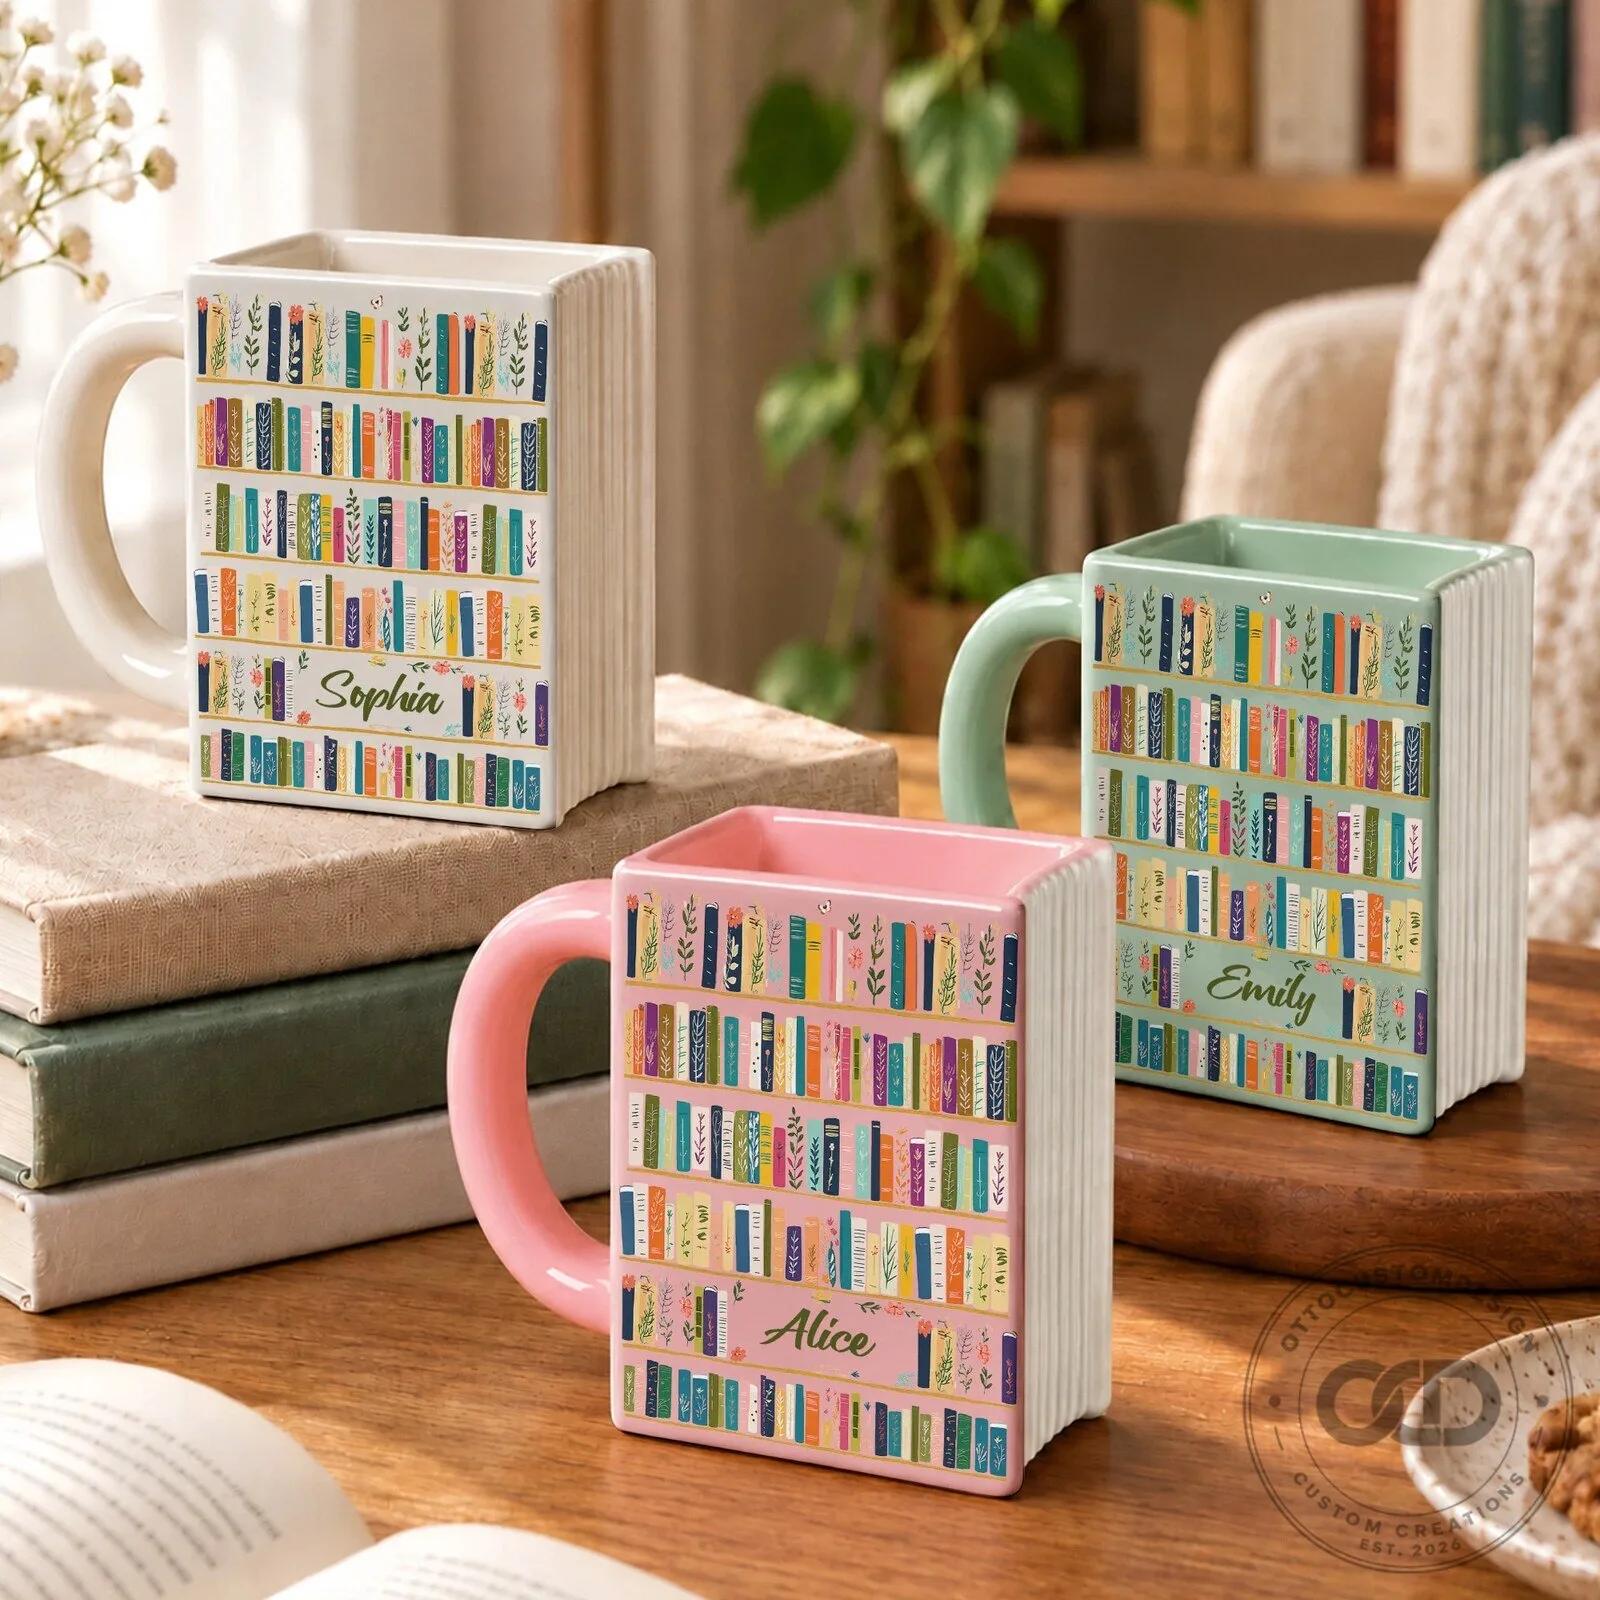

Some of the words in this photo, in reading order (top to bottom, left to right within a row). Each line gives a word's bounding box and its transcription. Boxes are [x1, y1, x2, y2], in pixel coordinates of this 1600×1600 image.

[315, 669, 444, 722] Sophia
[1206, 964, 1317, 1027] Emily
[759, 1307, 876, 1357] Alice
